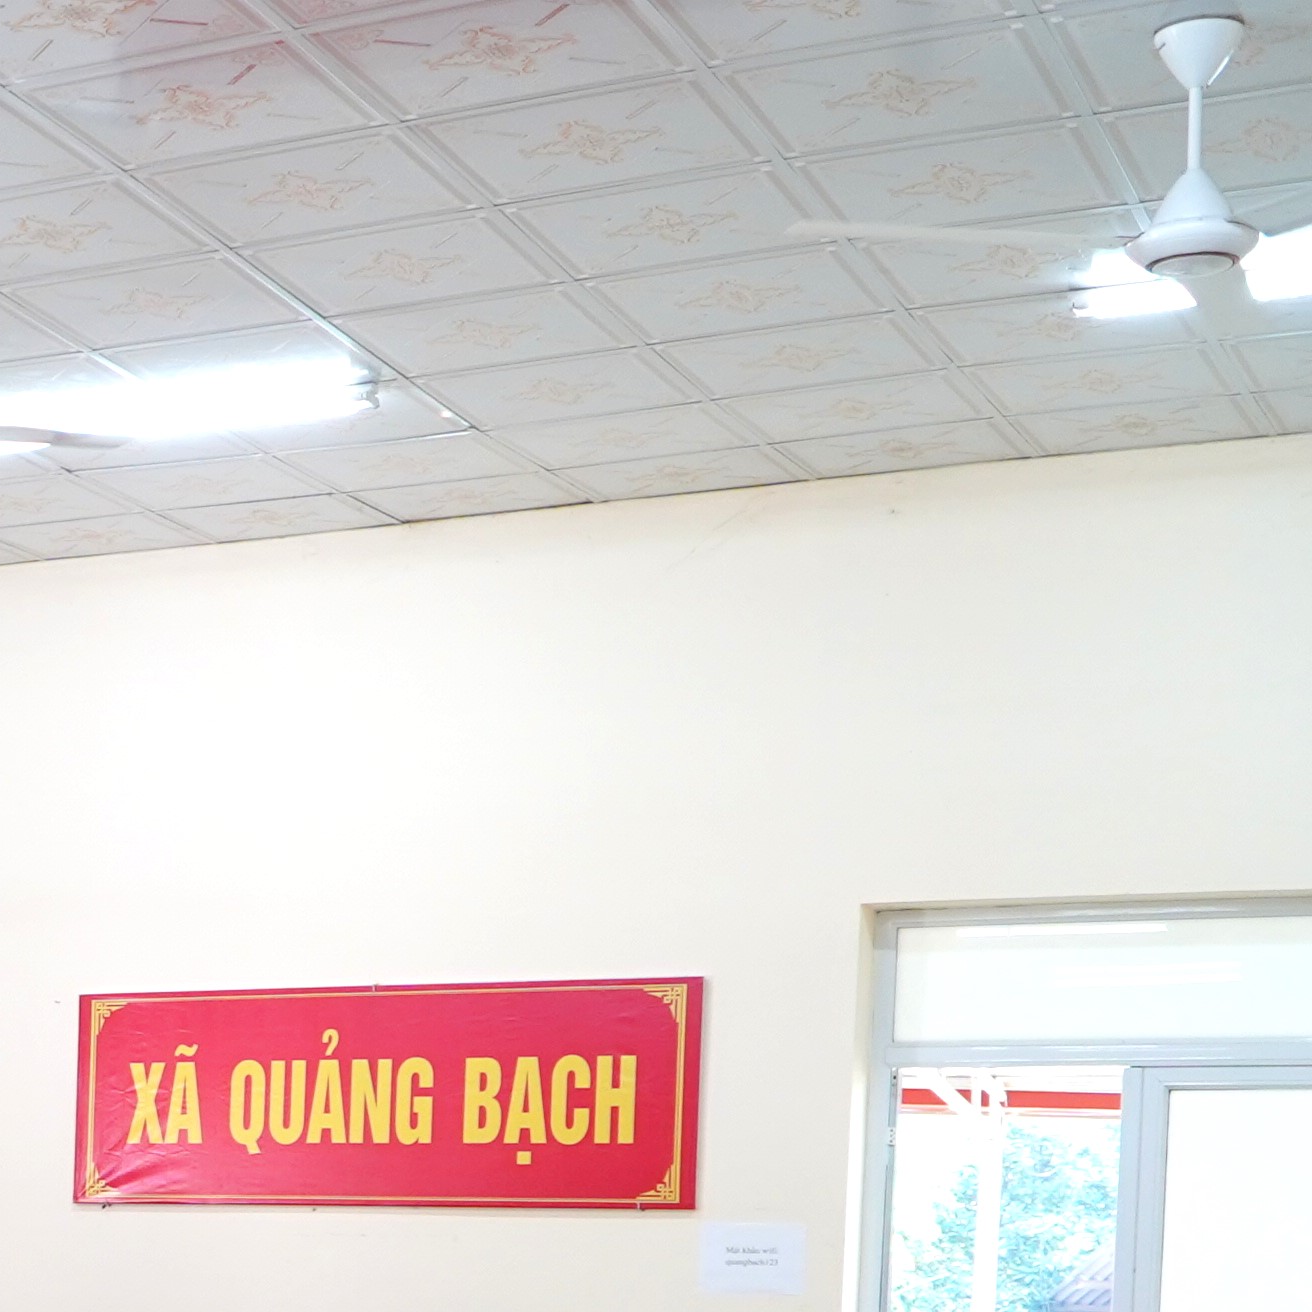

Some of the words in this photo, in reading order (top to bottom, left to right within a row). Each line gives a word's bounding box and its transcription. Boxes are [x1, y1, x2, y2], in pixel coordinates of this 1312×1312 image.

[126, 1044, 203, 1145] XÃ
[229, 1029, 435, 1154] QUẢNG
[462, 1053, 638, 1165] BẠCH
